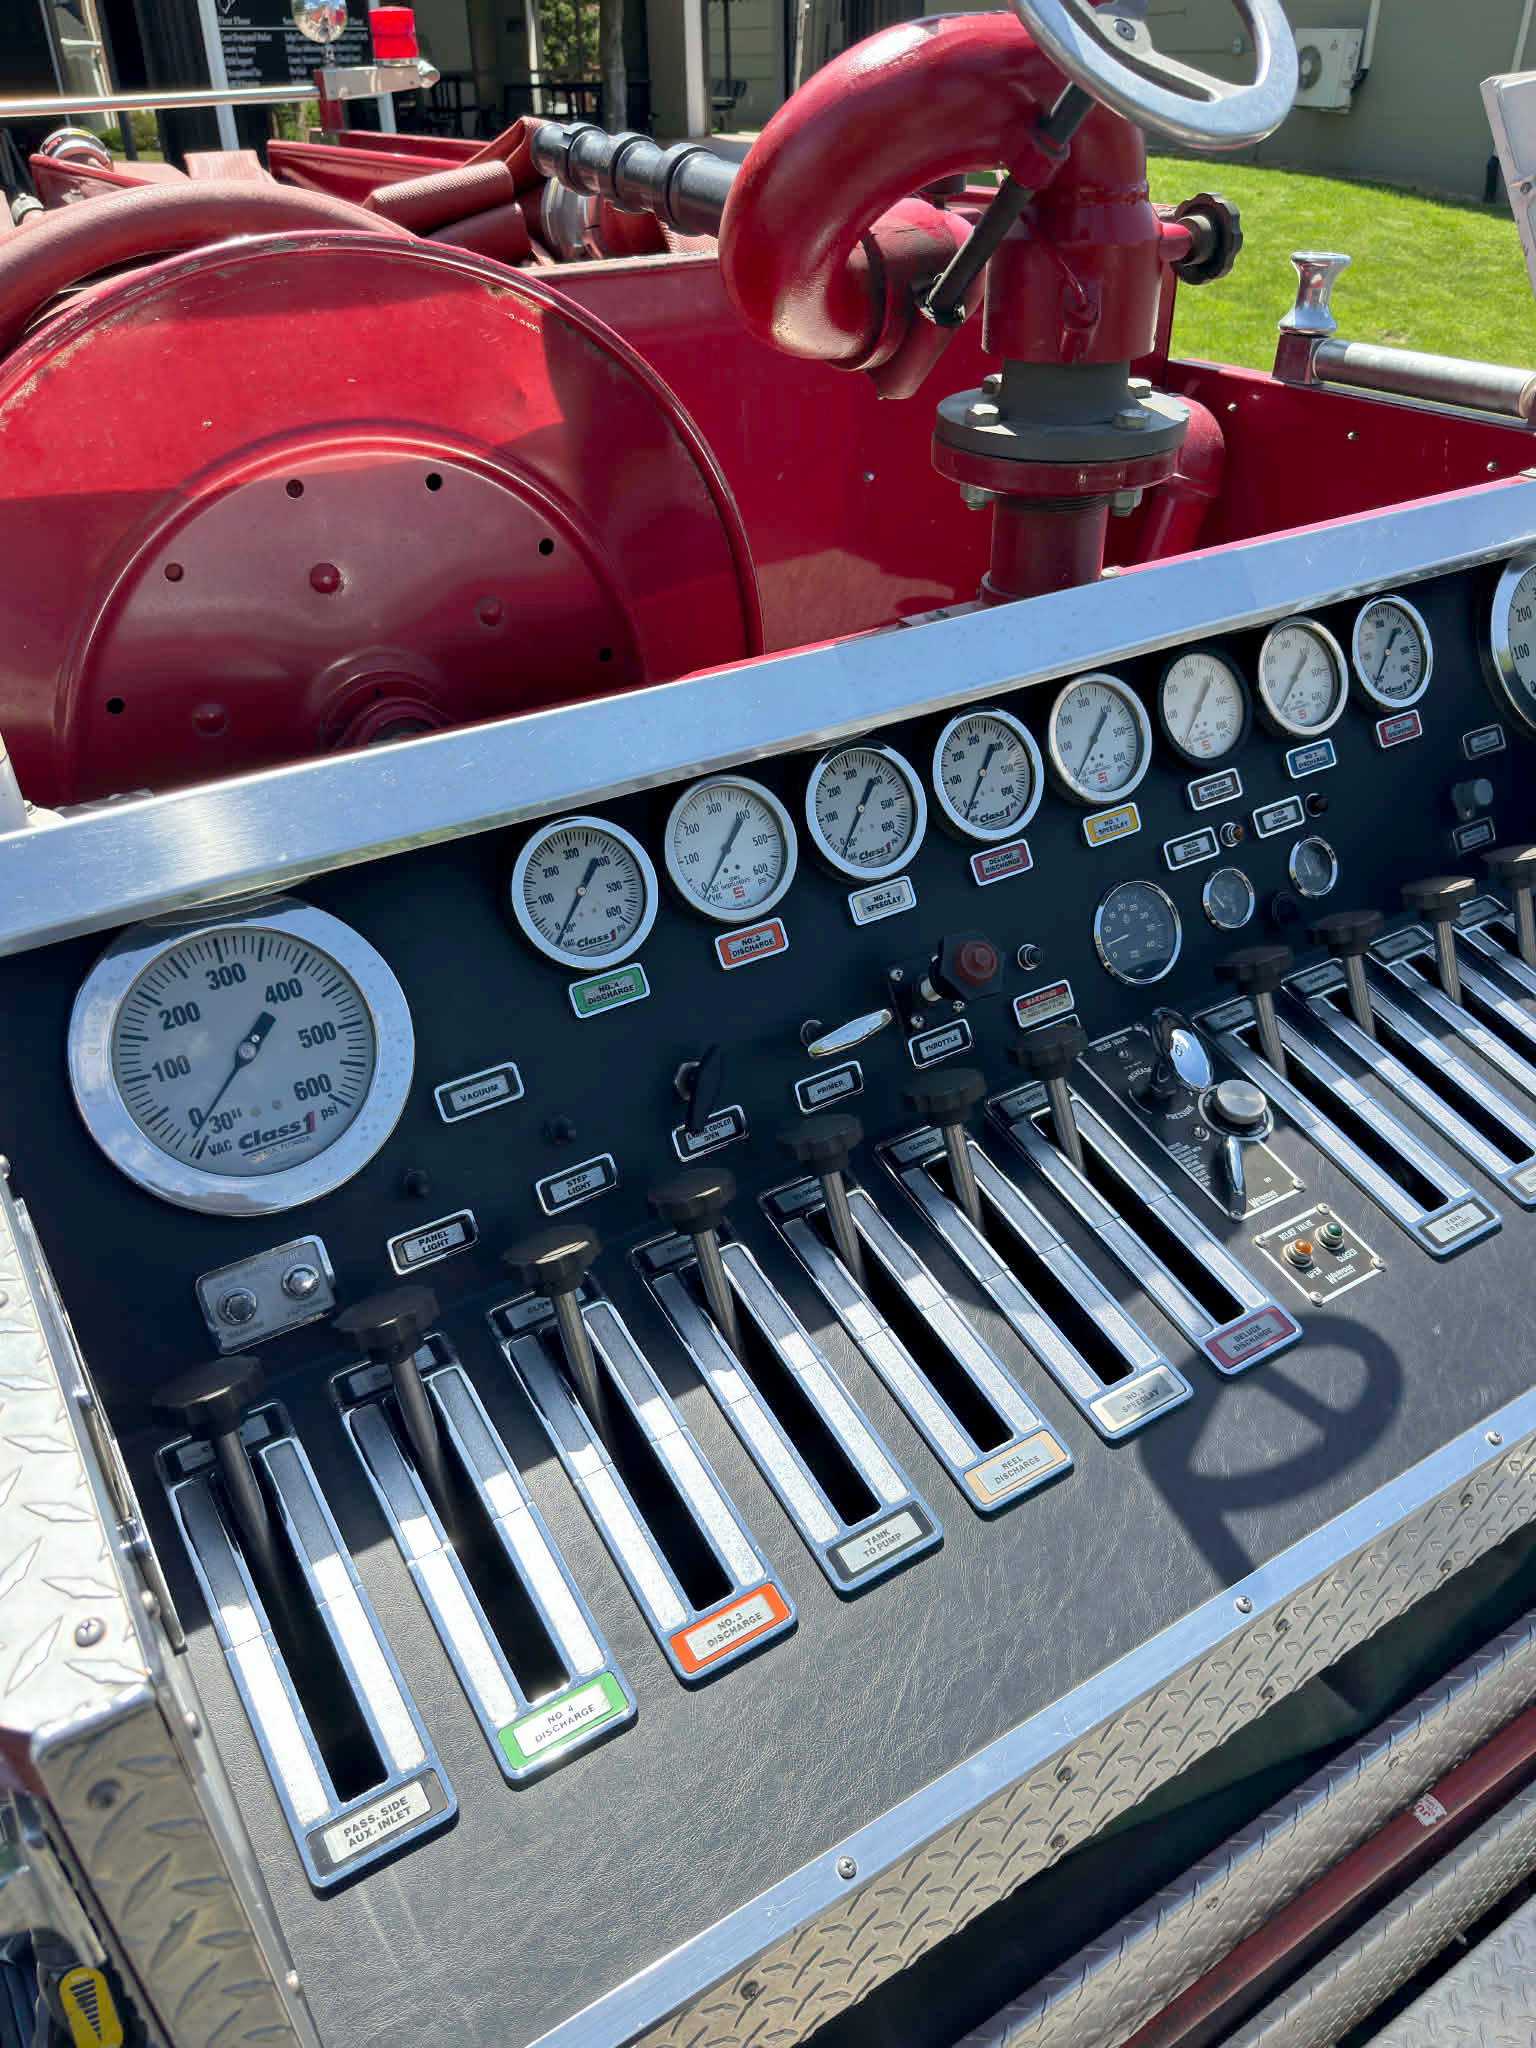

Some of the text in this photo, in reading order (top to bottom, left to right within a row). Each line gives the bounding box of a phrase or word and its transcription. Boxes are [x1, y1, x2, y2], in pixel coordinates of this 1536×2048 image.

[1516, 605, 1531, 623] 200
[1513, 643, 1529, 660] 100
[1077, 697, 1090, 709] 300
[1060, 715, 1072, 727] 200
[1113, 727, 1126, 738] 500
[1060, 741, 1072, 752] 100
[952, 750, 965, 762] 200
[1113, 752, 1126, 763] 600
[843, 769, 857, 781] 300
[1001, 764, 1013, 774] 500
[950, 774, 961, 785] 100
[827, 786, 841, 798] 200
[1001, 786, 1014, 797] 600
[706, 802, 722, 816] 300
[881, 798, 894, 810] 500
[735, 809, 750, 822] 400
[825, 811, 839, 824] 100
[684, 823, 700, 836] 200
[881, 821, 895, 833] 600
[752, 834, 768, 847] 500
[563, 848, 579, 860] 300
[858, 841, 891, 861] Class1
[684, 853, 700, 865] 100
[542, 865, 559, 879] 200
[752, 863, 768, 875] 600
[606, 881, 623, 893] 500
[701, 882, 708, 891] 0
[538, 893, 554, 905] 100
[866, 895, 901, 912] SPEEDLAY
[605, 906, 622, 918] 600
[577, 928, 617, 949] Class1
[731, 937, 774, 957] DISCHARGE
[205, 962, 247, 990] 300
[265, 978, 304, 1005] 400
[587, 984, 635, 1005] DISCHARGE
[159, 1002, 200, 1031] 200
[298, 1021, 337, 1049] 500
[924, 1035, 958, 1051] THROTTLE
[152, 1055, 191, 1082] 100
[294, 1073, 332, 1101] 600
[459, 1083, 498, 1102] VACUUM
[817, 1080, 843, 1095] PRIMER
[188, 1107, 204, 1128] 0
[320, 1105, 339, 1121] psi
[238, 1112, 316, 1150] Class1
[709, 1118, 731, 1132] COOLER
[704, 1131, 720, 1142] OPEN
[208, 1139, 233, 1156] VAC
[566, 1174, 588, 1188] STEP
[567, 1181, 592, 1196] LIGHT
[418, 1230, 449, 1246] PANEL
[422, 1238, 450, 1253] LIGHT
[1336, 1248, 1358, 1263] CLOSED
[1305, 1266, 1323, 1279] OPEN
[1325, 1264, 1357, 1285] Waterous
[1121, 1389, 1160, 1413] SPEEDLAY
[995, 1455, 1042, 1485] DISCHARGE
[1001, 1455, 1024, 1470] REEL
[863, 1532, 902, 1558] TO PUMP
[865, 1529, 891, 1547] TANK
[706, 1612, 763, 1648] DISCHARGE
[534, 1703, 596, 1743] DISCHARGE
[343, 1796, 409, 1837] PASS. SIDE
[349, 1805, 412, 1849] AUX. INLET
